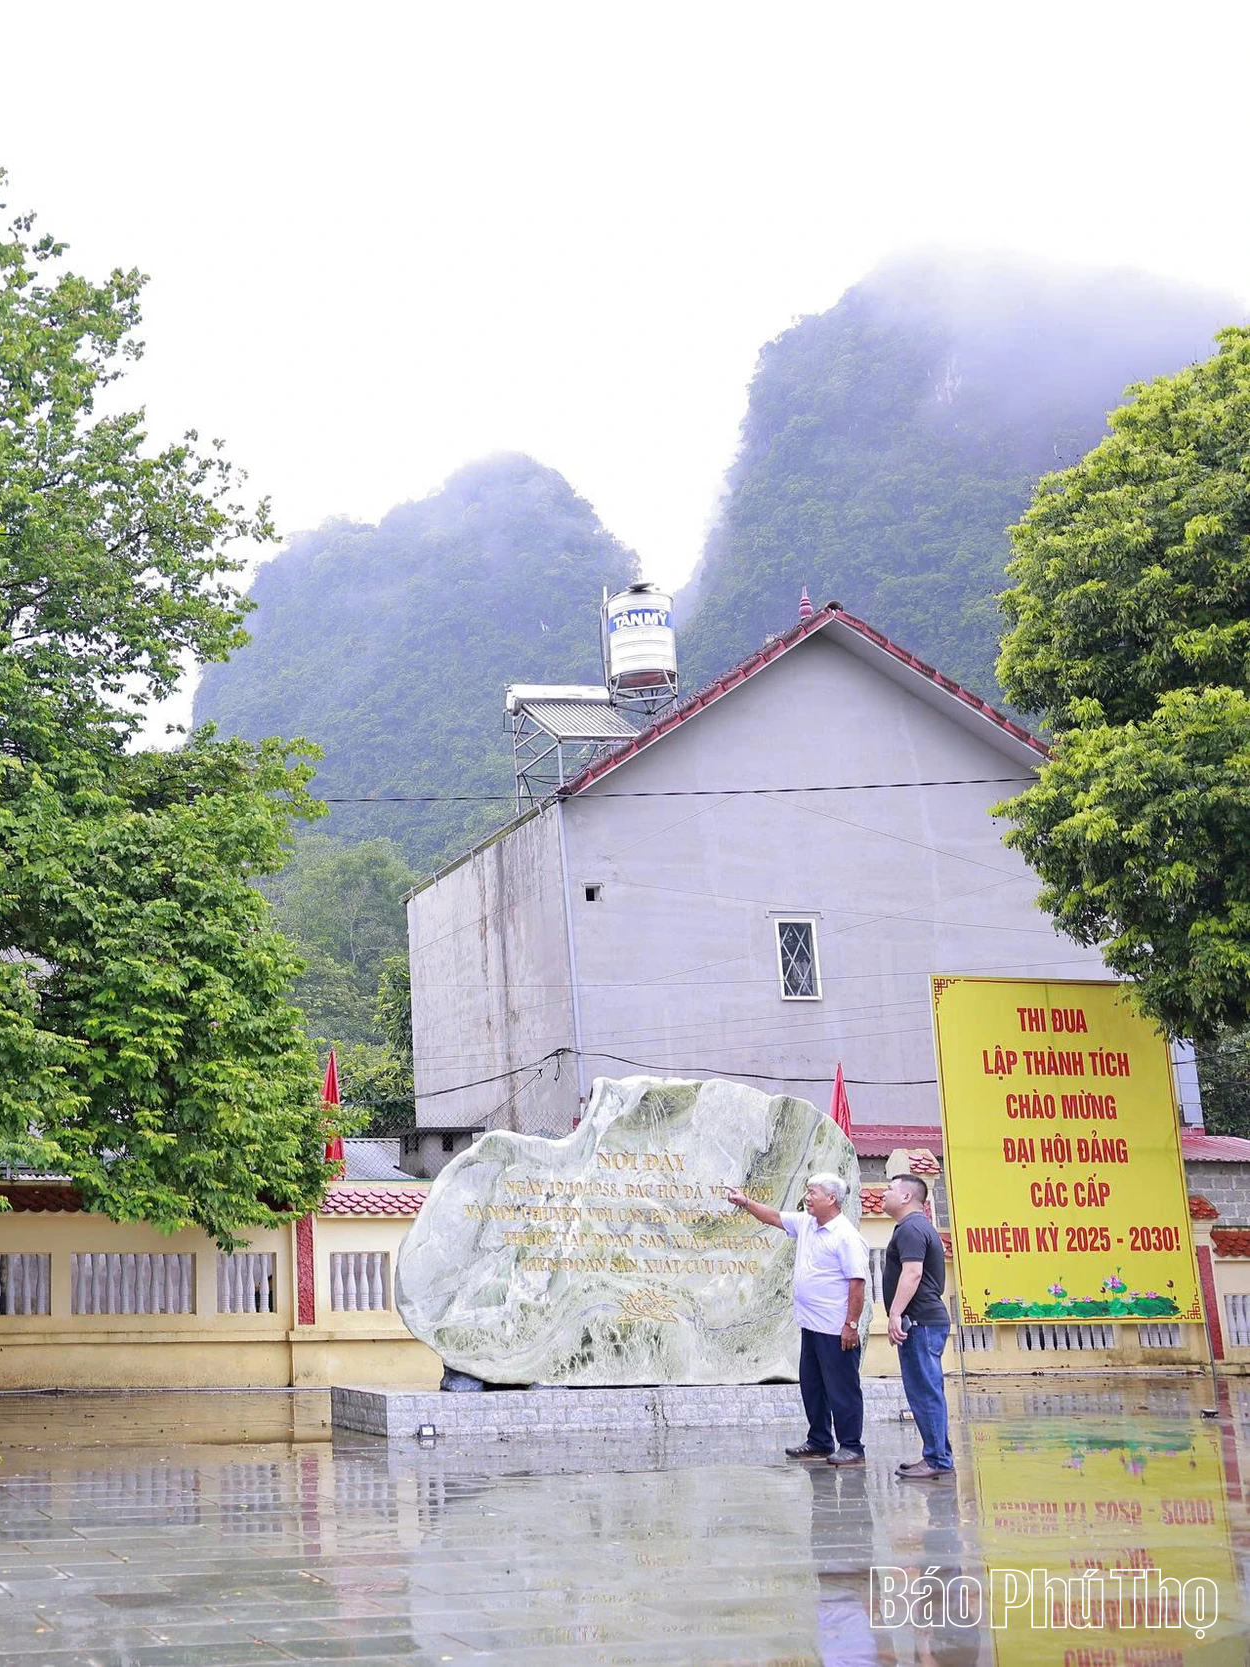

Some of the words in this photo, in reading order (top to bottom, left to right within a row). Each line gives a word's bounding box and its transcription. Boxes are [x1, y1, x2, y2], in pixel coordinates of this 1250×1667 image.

[1016, 1007, 1046, 1032] THI
[1051, 1008, 1088, 1033] ĐUA
[982, 1045, 1018, 1080] LẬP
[1023, 1046, 1085, 1077] THÀNH
[1088, 1047, 1130, 1077] TÍCH
[1006, 1089, 1056, 1119] CHÀO
[1061, 1089, 1117, 1119] MỪNG
[596, 1151, 638, 1171] NƠI
[1003, 1137, 1035, 1168] ĐẠI
[1042, 1133, 1072, 1168] HỘI
[1077, 1130, 1129, 1164] ĐẢNG
[503, 1176, 544, 1196] NGÀY
[1030, 1177, 1068, 1208] CÁC
[1073, 1173, 1110, 1208] CẤP
[966, 1222, 1030, 1258] NHIỆM
[1036, 1222, 1060, 1253] KỲ
[1066, 1227, 1111, 1252] 2025
[1117, 1236, 1124, 1244] -
[1130, 1227, 1181, 1251] 2030!
[717, 1259, 759, 1275] LONG
